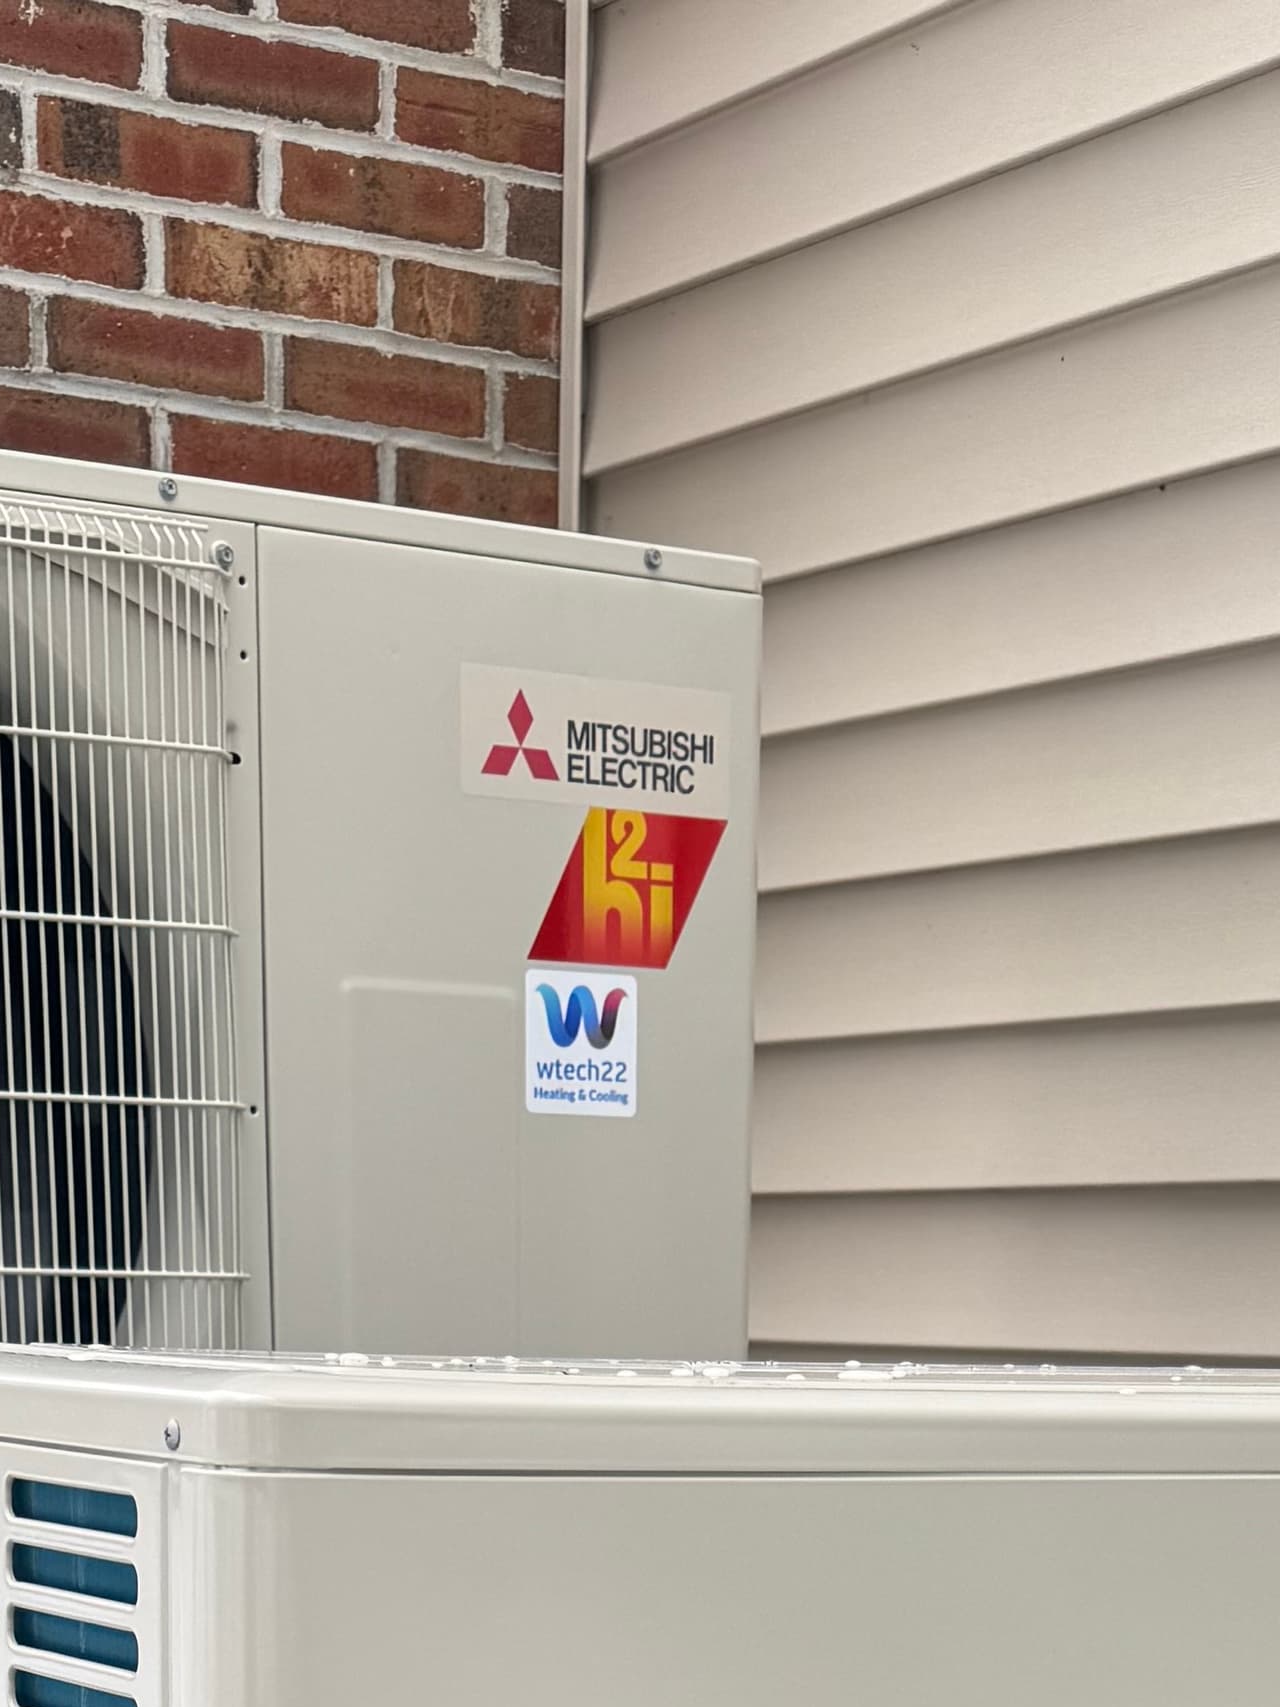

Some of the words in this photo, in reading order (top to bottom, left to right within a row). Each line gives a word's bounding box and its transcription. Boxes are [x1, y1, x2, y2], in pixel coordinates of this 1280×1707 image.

[567, 719, 714, 765] MITSUBISHI
[567, 754, 696, 795] ELECTRIC
[536, 1058, 628, 1083] wtech22
[533, 1087, 576, 1104] Heating
[578, 1089, 587, 1102] &
[588, 1089, 629, 1106] Cooling
